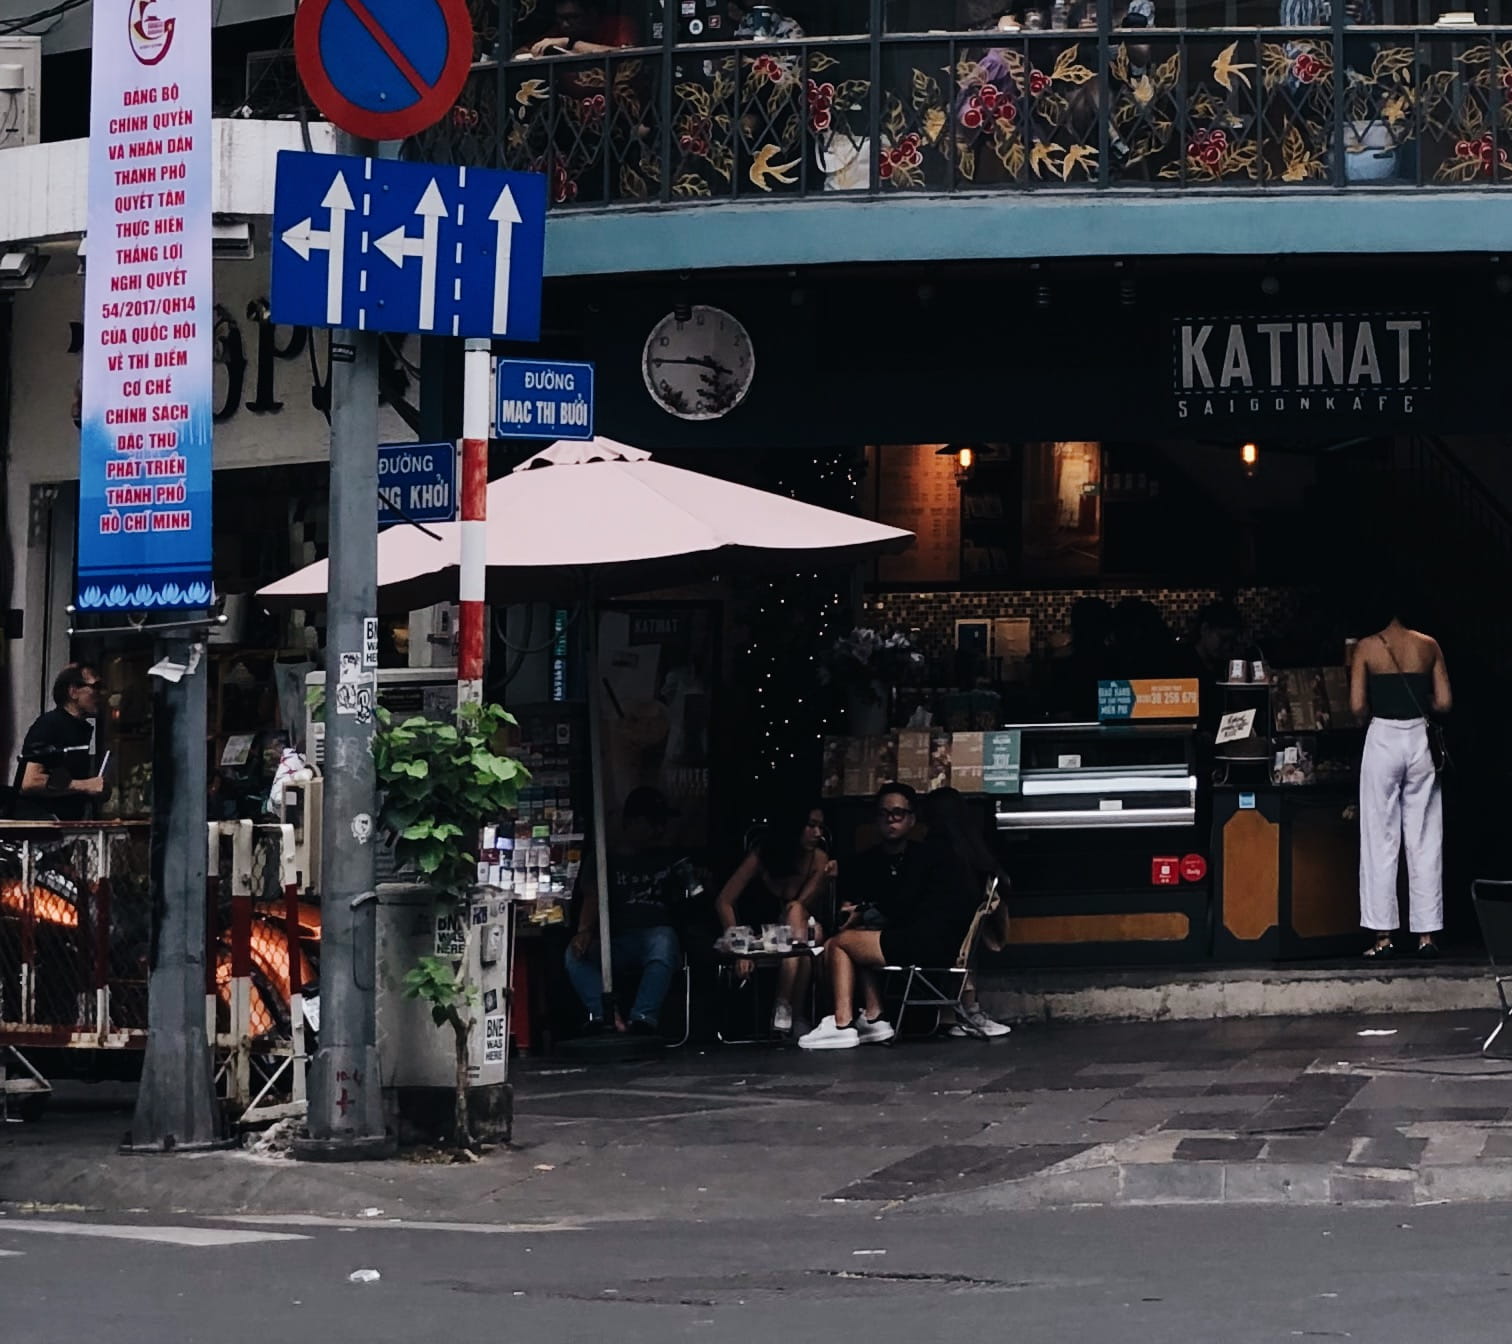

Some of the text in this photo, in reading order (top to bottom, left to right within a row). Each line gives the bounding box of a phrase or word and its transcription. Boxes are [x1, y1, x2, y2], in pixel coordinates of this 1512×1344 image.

[161, 82, 179, 103] BỘ
[109, 108, 193, 135] CHÍNH QUYỀN
[108, 135, 193, 161] VÀ NHÂN DÂN
[114, 160, 186, 187] THÀNH PHỐ
[115, 188, 186, 214] QUYẾT TÂM
[116, 219, 151, 240] THỰC
[146, 266, 187, 289] QUYẾT
[102, 295, 196, 319] 54/2017/QH14
[131, 320, 169, 343] QUỐC
[173, 321, 196, 341] HỘI
[108, 350, 124, 372] VỀ
[1180, 319, 1422, 389] KATINAT
[123, 373, 172, 397] CƠ CHẾ
[525, 369, 574, 391] ĐƯỜNG
[105, 401, 189, 425] CHÍNH SÁCH
[502, 392, 588, 430] MẠC THỊ BƯỞI
[1177, 395, 1417, 418] SAIGONKAFE
[106, 453, 186, 479] PHÁT TRIỂN
[378, 452, 433, 475] ĐƯỜNG
[106, 478, 186, 506] THÀNH PHỐ
[378, 473, 449, 511] NG KHỞI
[101, 508, 191, 533] HỒ CHÍ MINH
[486, 1018, 505, 1039] BNE
